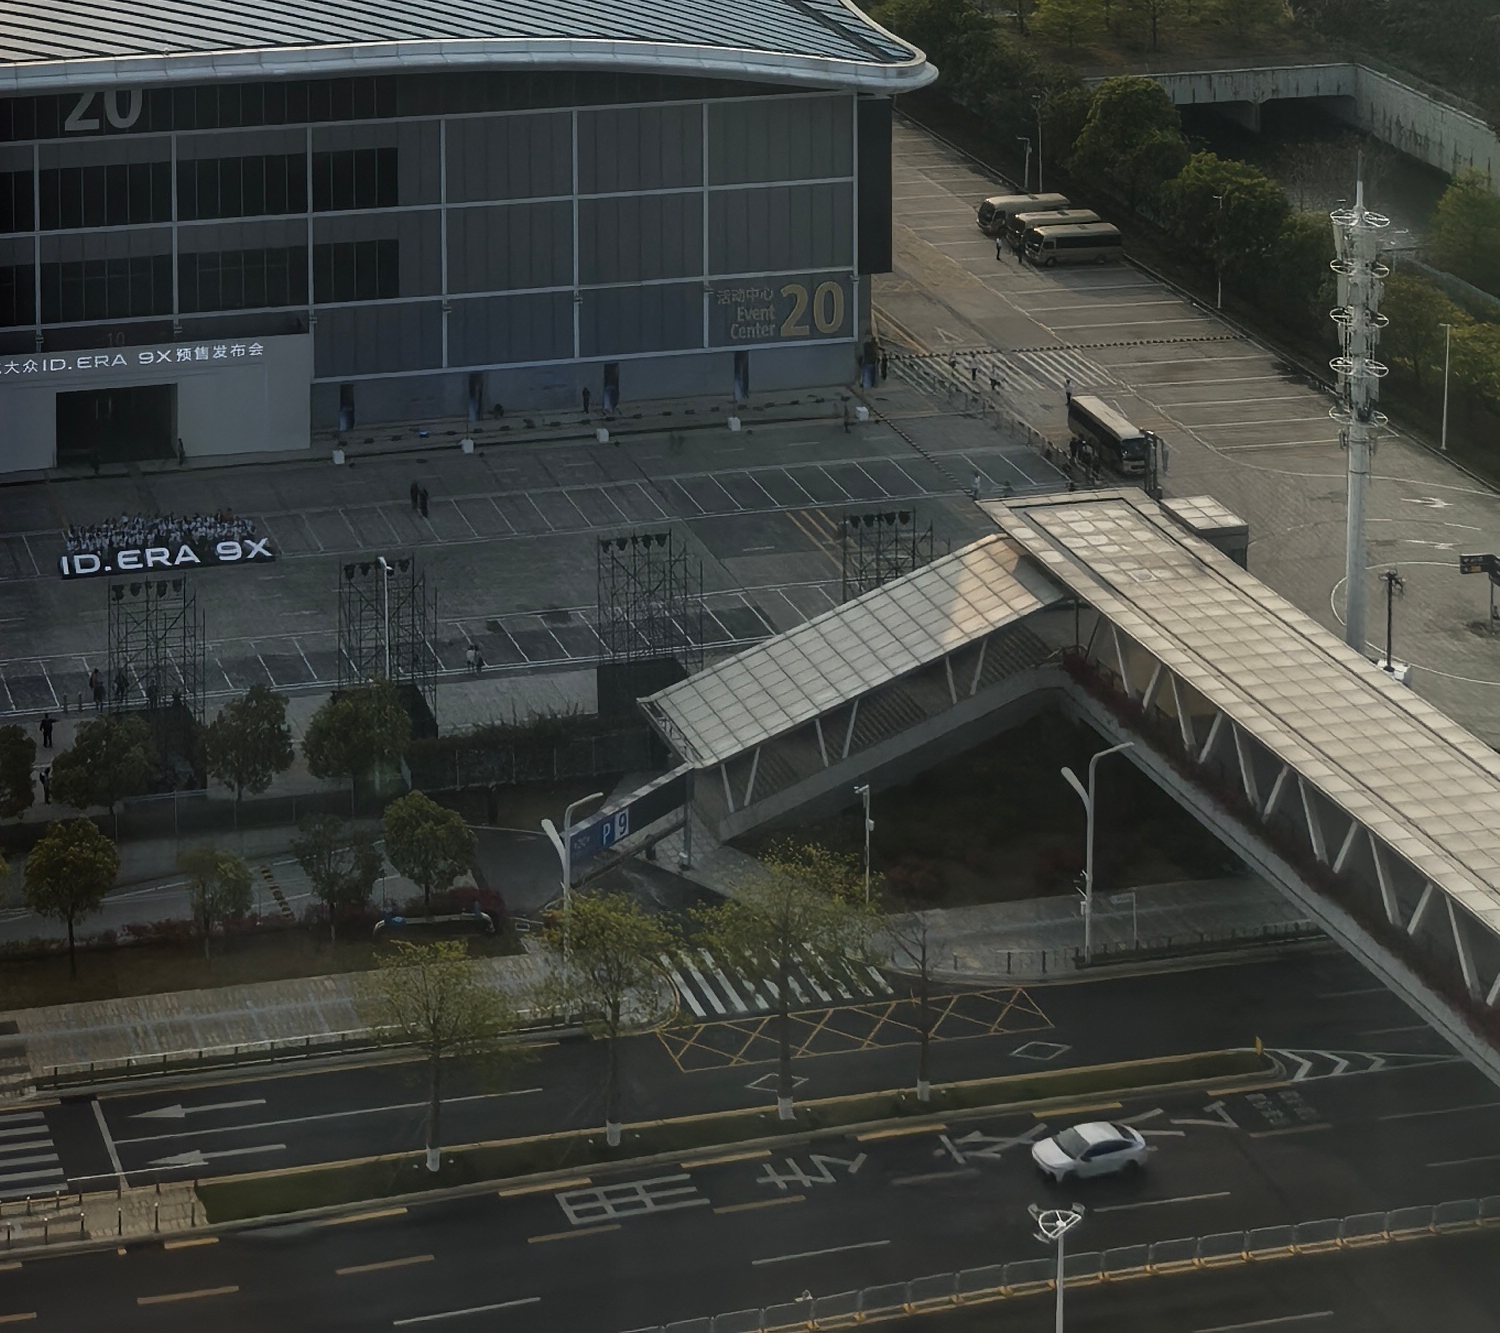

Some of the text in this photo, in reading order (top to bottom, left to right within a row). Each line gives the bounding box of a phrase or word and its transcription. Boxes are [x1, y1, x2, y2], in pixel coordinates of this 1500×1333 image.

[64, 89, 143, 131] 20
[737, 305, 776, 323] Event
[780, 280, 845, 337] 20
[730, 322, 776, 340] Center
[60, 537, 274, 576] ID.ERA 9X
[603, 823, 611, 845] P
[619, 813, 627, 835] 9
